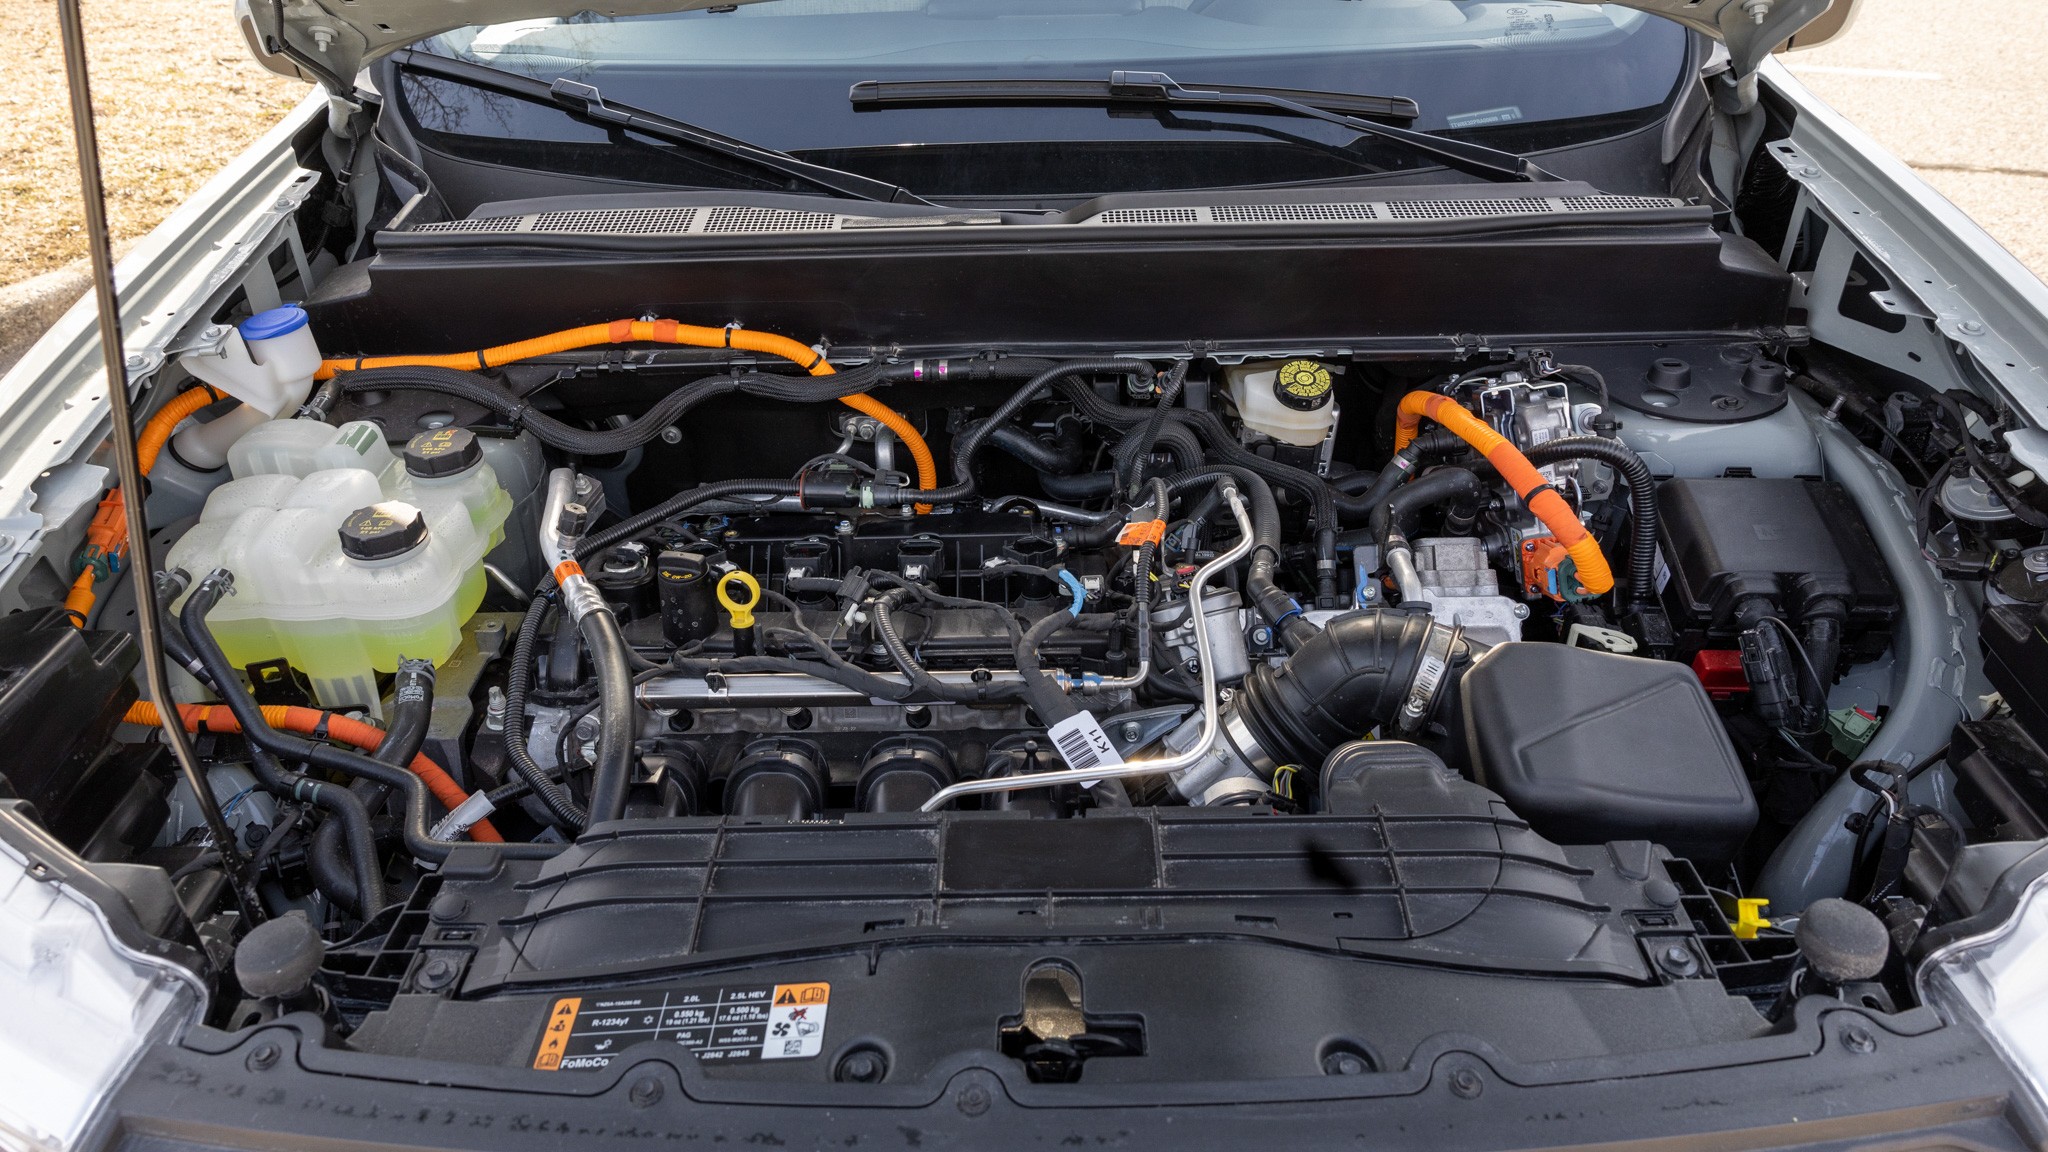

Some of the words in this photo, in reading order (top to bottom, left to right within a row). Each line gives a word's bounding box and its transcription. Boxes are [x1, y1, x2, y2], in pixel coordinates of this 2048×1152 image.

[1088, 729, 1110, 753] K11
[683, 995, 700, 1003] 2.0L
[730, 992, 747, 1000] 2.5L
[748, 991, 766, 999] HEV
[695, 1010, 705, 1019] kg
[750, 1006, 760, 1015] kg
[591, 1017, 630, 1027] R-1234yf
[733, 1028, 748, 1036] POE
[560, 1057, 609, 1069] FoMoCo
